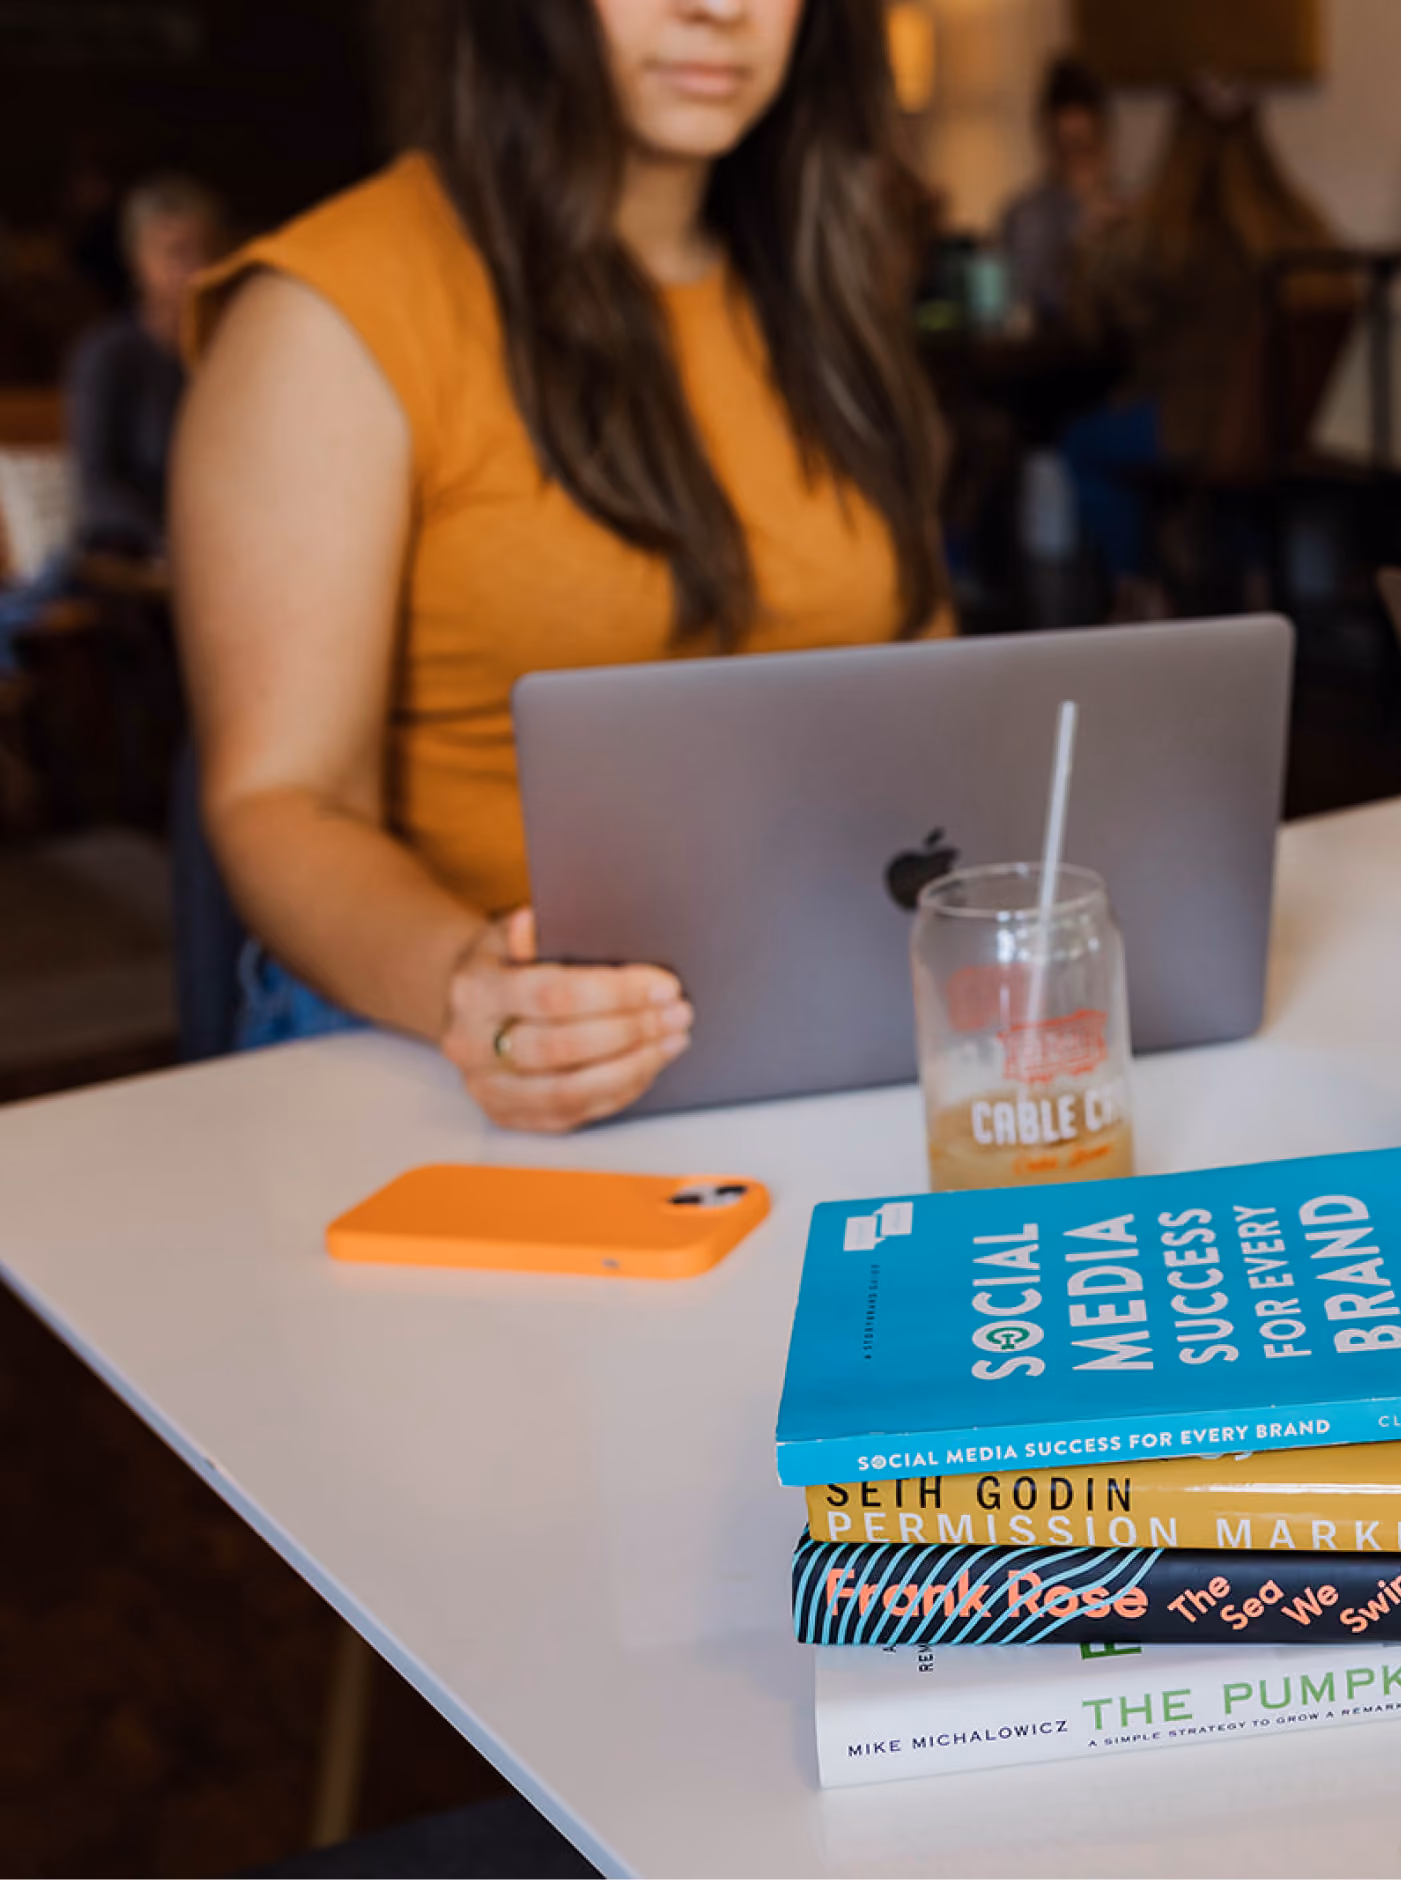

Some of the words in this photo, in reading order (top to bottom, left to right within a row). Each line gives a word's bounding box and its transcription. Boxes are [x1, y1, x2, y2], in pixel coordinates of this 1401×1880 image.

[971, 1096, 1076, 1145] CABLE
[1233, 1205, 1294, 1290] EVERY
[972, 1223, 1045, 1380] SOCIAL
[1063, 1213, 1153, 1371] MEDIA
[1157, 1208, 1239, 1366] SUCCESS
[1255, 1298, 1312, 1359] FOR
[858, 1449, 940, 1471] SOCIAL
[946, 1444, 1018, 1465] MEDIA
[1025, 1437, 1122, 1459] SUCCESS
[1129, 1432, 1173, 1449] FOR
[1181, 1425, 1249, 1446] EVERY
[1256, 1419, 1331, 1440] BRAND
[826, 1476, 942, 1509] SETH
[976, 1476, 1132, 1512] GODIN
[827, 1511, 1178, 1548] PERMISSION
[826, 1568, 991, 1619] Frank
[1008, 1569, 1148, 1619] Rose
[1167, 1575, 1232, 1624] The
[1220, 1579, 1285, 1631] Sea
[1280, 1583, 1339, 1627] We
[1082, 1689, 1192, 1730] THE
[1104, 1732, 1160, 1746] SIMPLE
[1169, 1721, 1246, 1738] STRATEGY
[1252, 1719, 1270, 1727] TO
[1276, 1711, 1319, 1724] GROW
[848, 1740, 901, 1757] MIKE
[912, 1720, 1068, 1749] MICHALOWICZ
